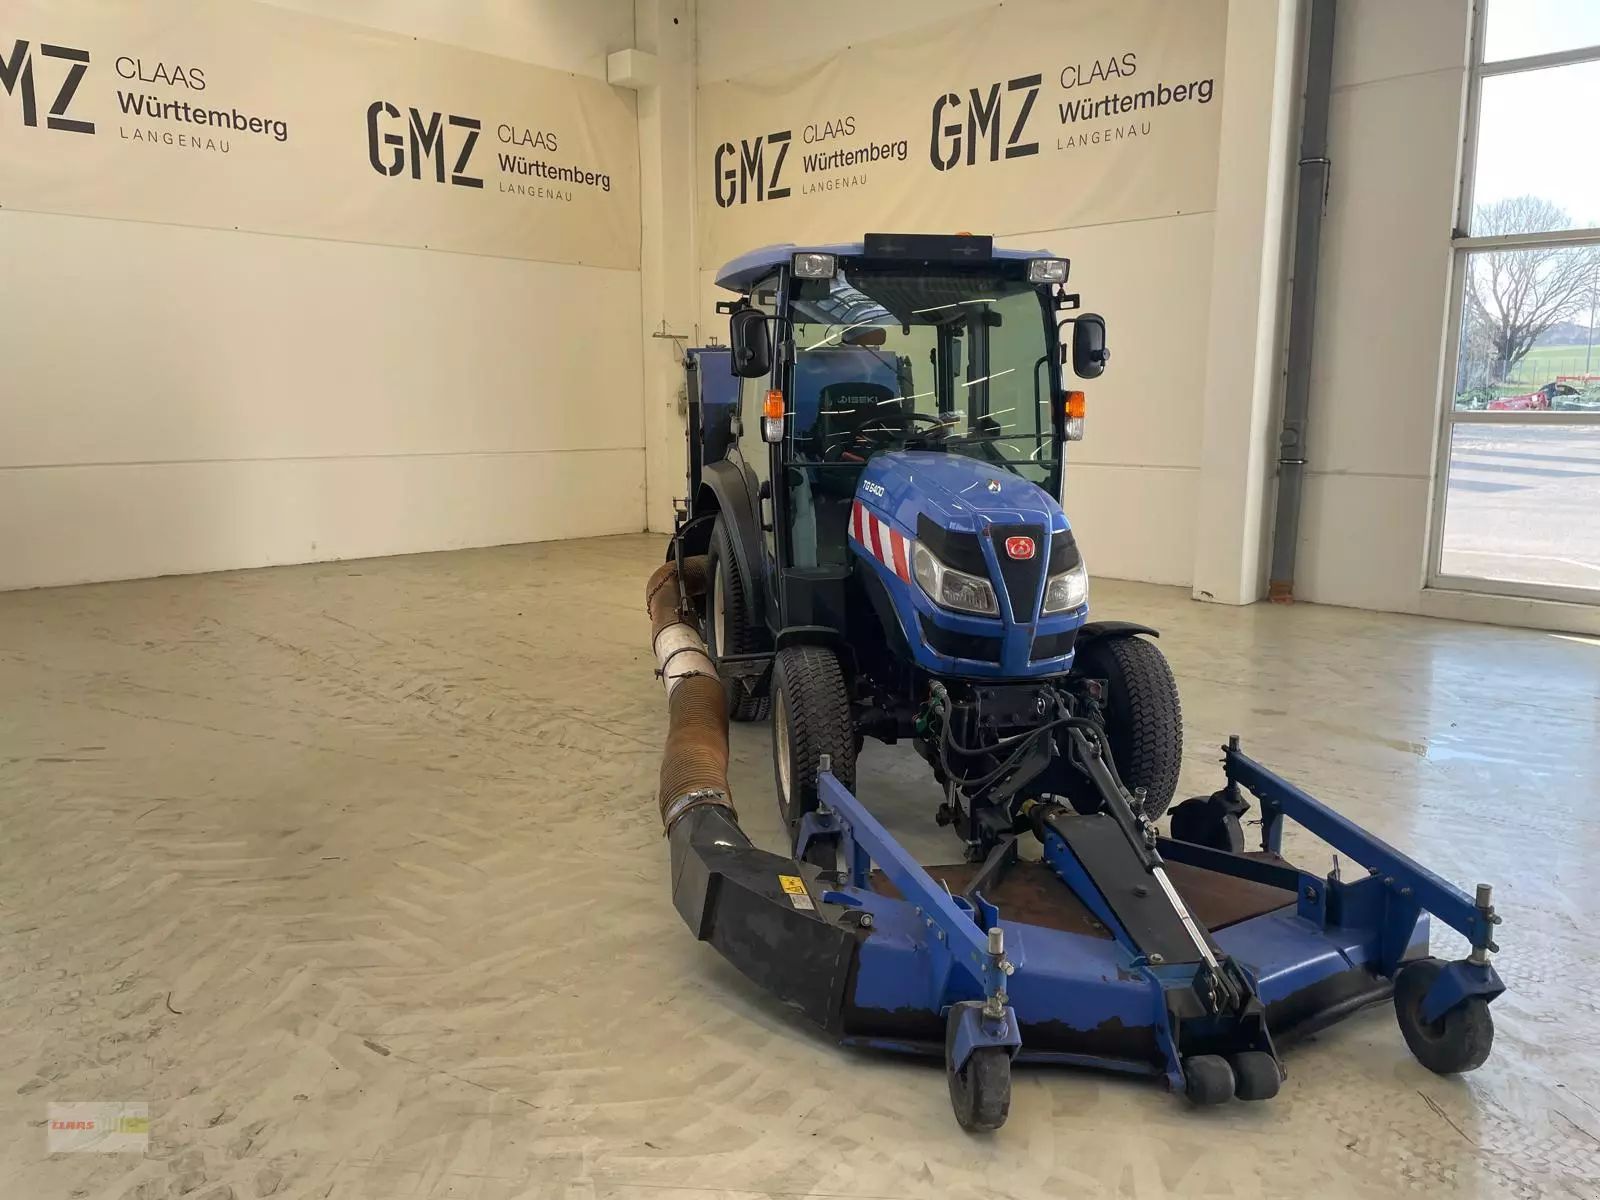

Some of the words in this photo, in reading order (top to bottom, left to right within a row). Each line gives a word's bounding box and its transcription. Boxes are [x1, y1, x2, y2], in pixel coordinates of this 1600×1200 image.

[115, 57, 206, 92] CLAAS
[1059, 53, 1137, 90] CLAAS
[117, 91, 288, 142] Württemberg
[1059, 79, 1214, 124] Württemberg
[120, 126, 231, 154] LANGENAU
[498, 125, 558, 151] CLAAS
[803, 116, 856, 145] CLAAS
[930, 73, 1042, 172] GMZ
[1057, 120, 1152, 151] LANGENAU
[367, 101, 485, 190] GMZ
[803, 140, 908, 173] Württemberg
[498, 154, 610, 192] Württemberg
[714, 130, 792, 209] GMZ
[802, 174, 868, 195] LANGENAU
[500, 181, 572, 202] LANGENAU
